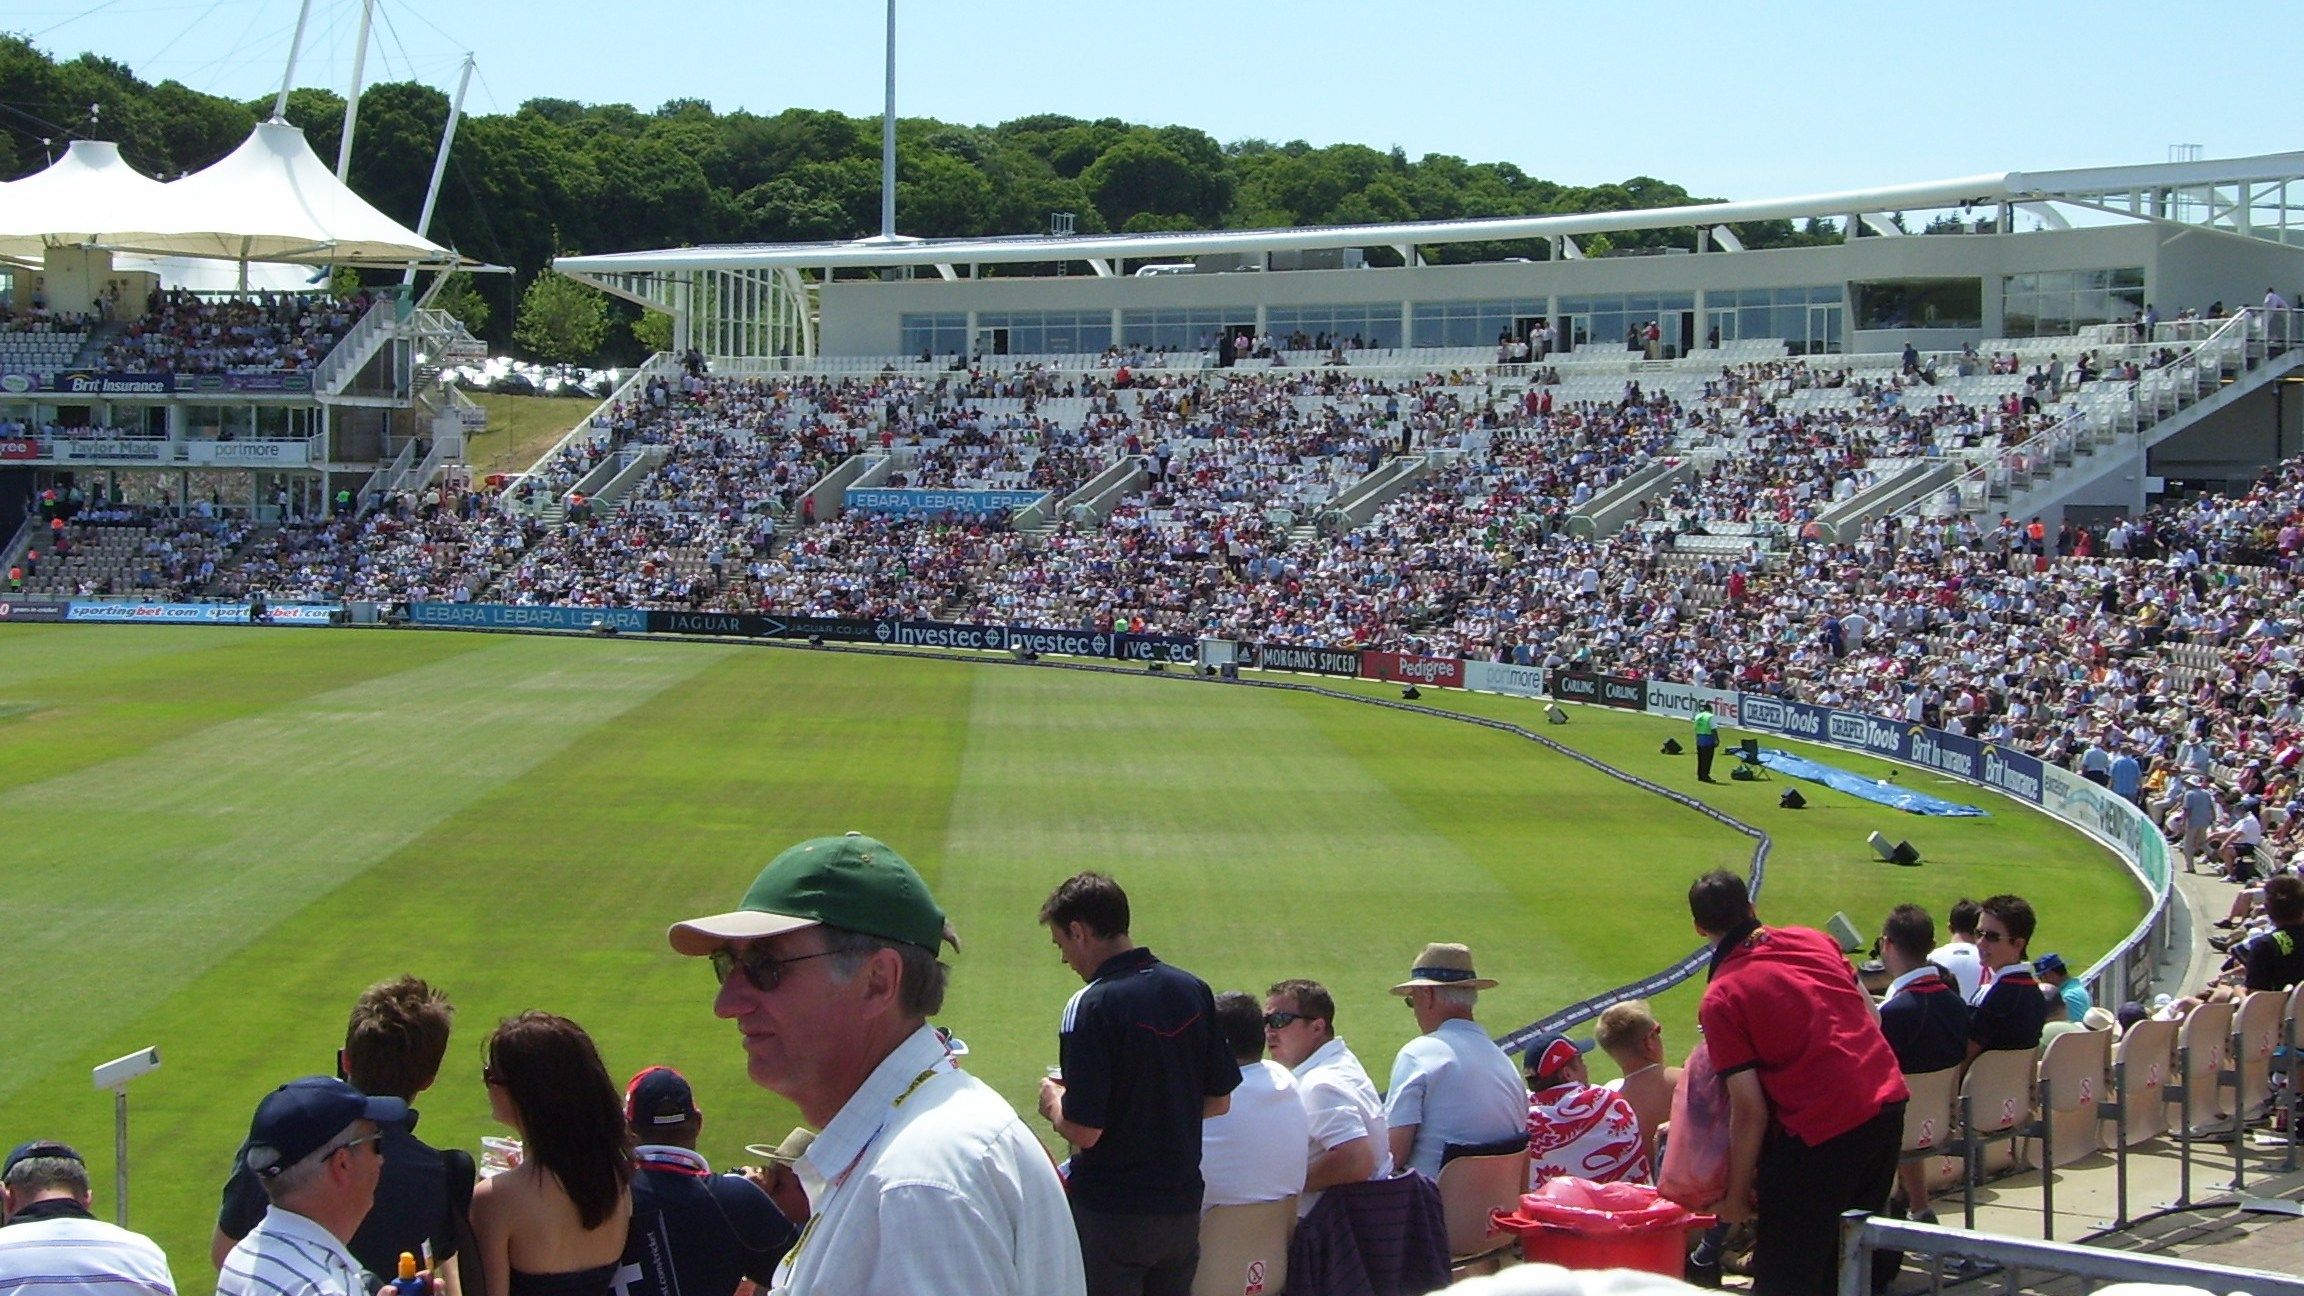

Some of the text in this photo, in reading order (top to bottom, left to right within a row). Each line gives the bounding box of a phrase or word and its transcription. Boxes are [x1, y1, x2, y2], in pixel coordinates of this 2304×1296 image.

[72, 377, 164, 393] Brit Insurance
[215, 443, 280, 459] portmore
[848, 494, 911, 507] LEBARA
[916, 496, 976, 509] LEBARA
[415, 604, 641, 628] LEBARA LEBARA LEBARA
[669, 615, 741, 632] JAGUAR
[894, 621, 982, 648] Investec
[1003, 628, 1089, 654] Investec
[1263, 648, 1356, 673] MORGAN'S SPICED
[1399, 657, 1454, 682] Pedigree
[1487, 666, 1540, 689] portmore
[1785, 705, 1820, 735] Tools
[1867, 720, 1900, 751] Tools
[1911, 734, 1932, 765] Brit
[1985, 753, 2004, 786] Brit
